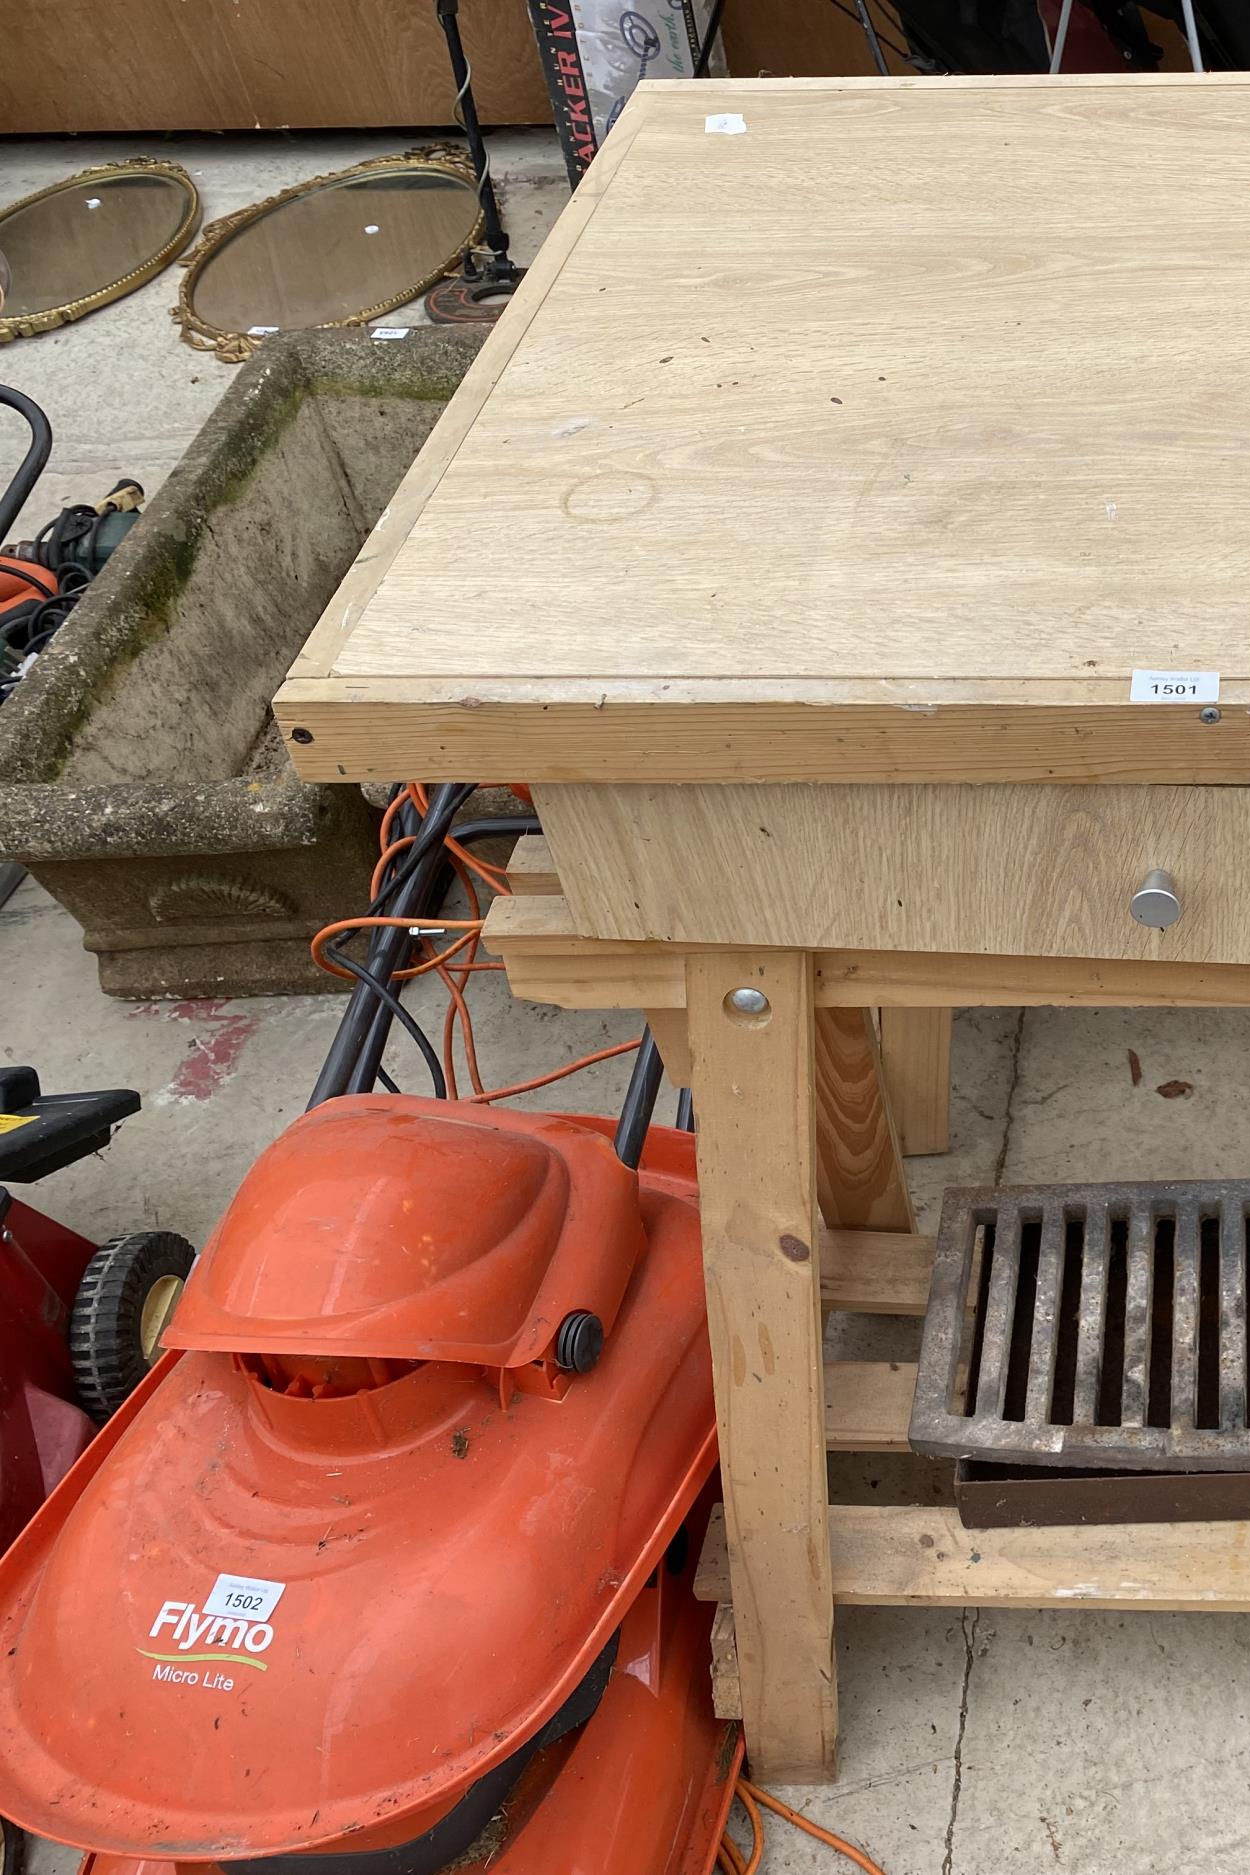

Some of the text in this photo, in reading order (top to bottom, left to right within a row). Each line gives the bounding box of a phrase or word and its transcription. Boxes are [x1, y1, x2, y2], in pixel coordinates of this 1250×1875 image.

[546, 3, 593, 172] ACKER IV
[1150, 684, 1197, 695] 1501
[225, 1592, 264, 1611] 1502
[148, 1600, 274, 1653] Flymo
[152, 1664, 234, 1691] Micro Lite
